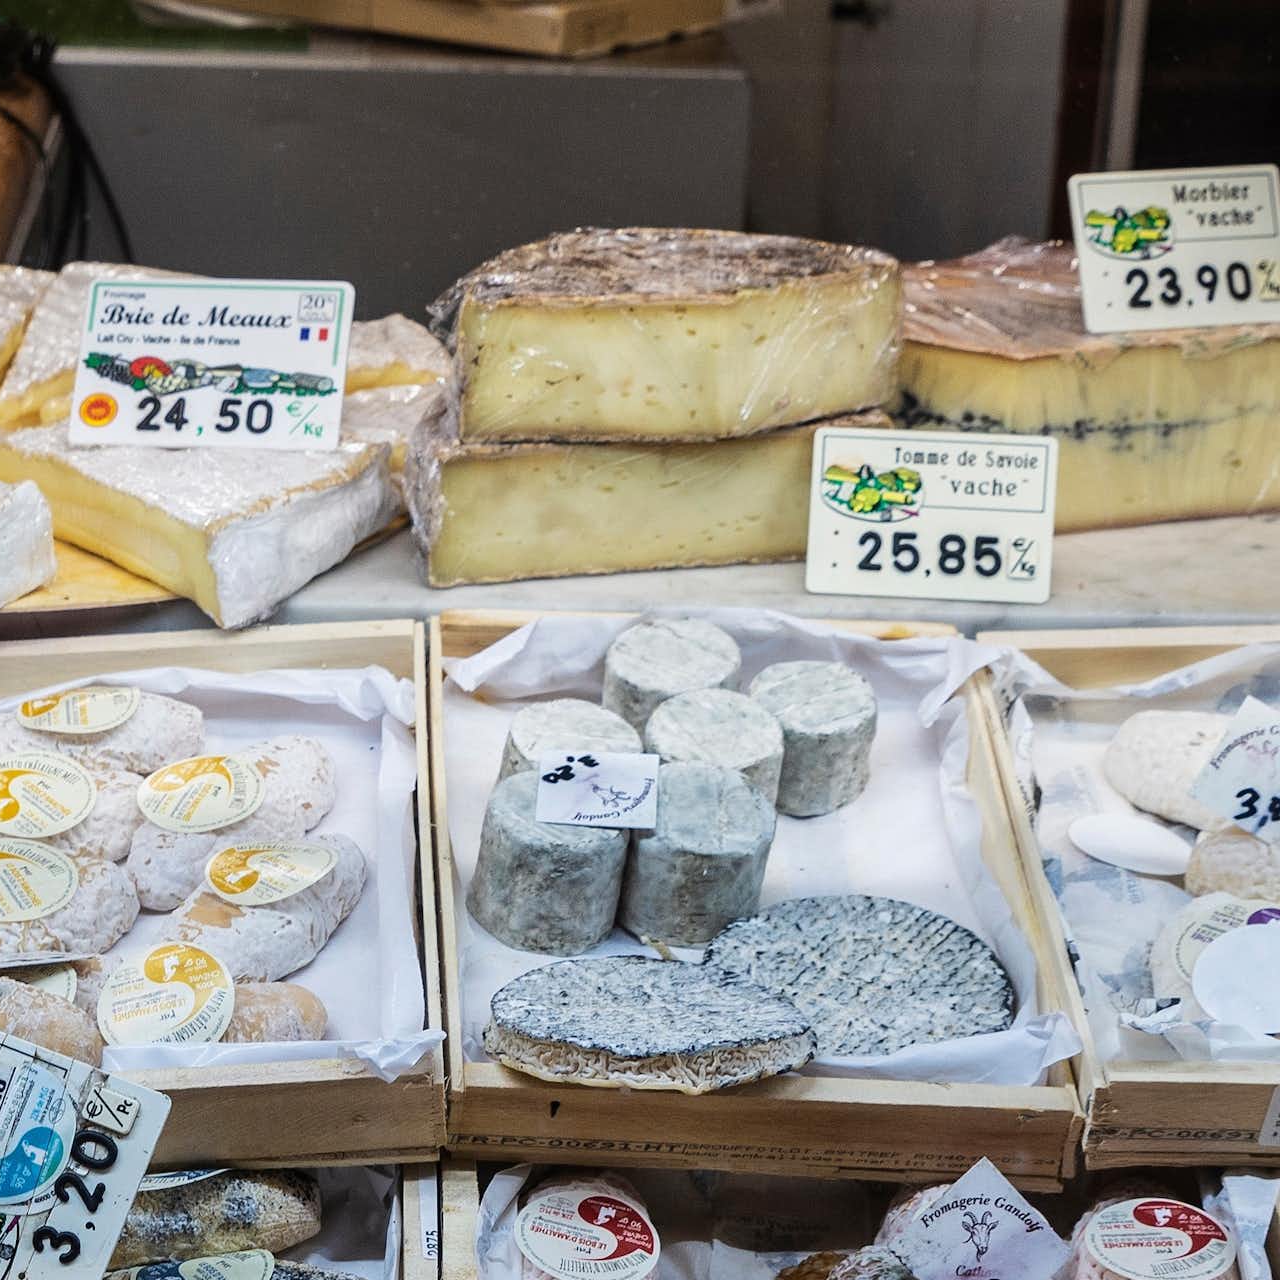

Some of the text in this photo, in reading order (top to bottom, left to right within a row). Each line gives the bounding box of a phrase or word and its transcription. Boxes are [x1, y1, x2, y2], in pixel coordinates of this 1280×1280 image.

[1173, 183, 1250, 203] Morbier
[100, 303, 293, 328] Brie de Meaux
[116, 335, 134, 344] Cru
[142, 335, 170, 344] Vache
[193, 336, 205, 345] de
[208, 336, 240, 346] France
[136, 397, 273, 436] 24,50
[896, 447, 1038, 469] Tomme de Savoie
[858, 531, 1002, 577] 25,85
[33, 1129, 118, 1264] 3,20
[920, 1195, 1045, 1234] Fromagerie Gandolf
